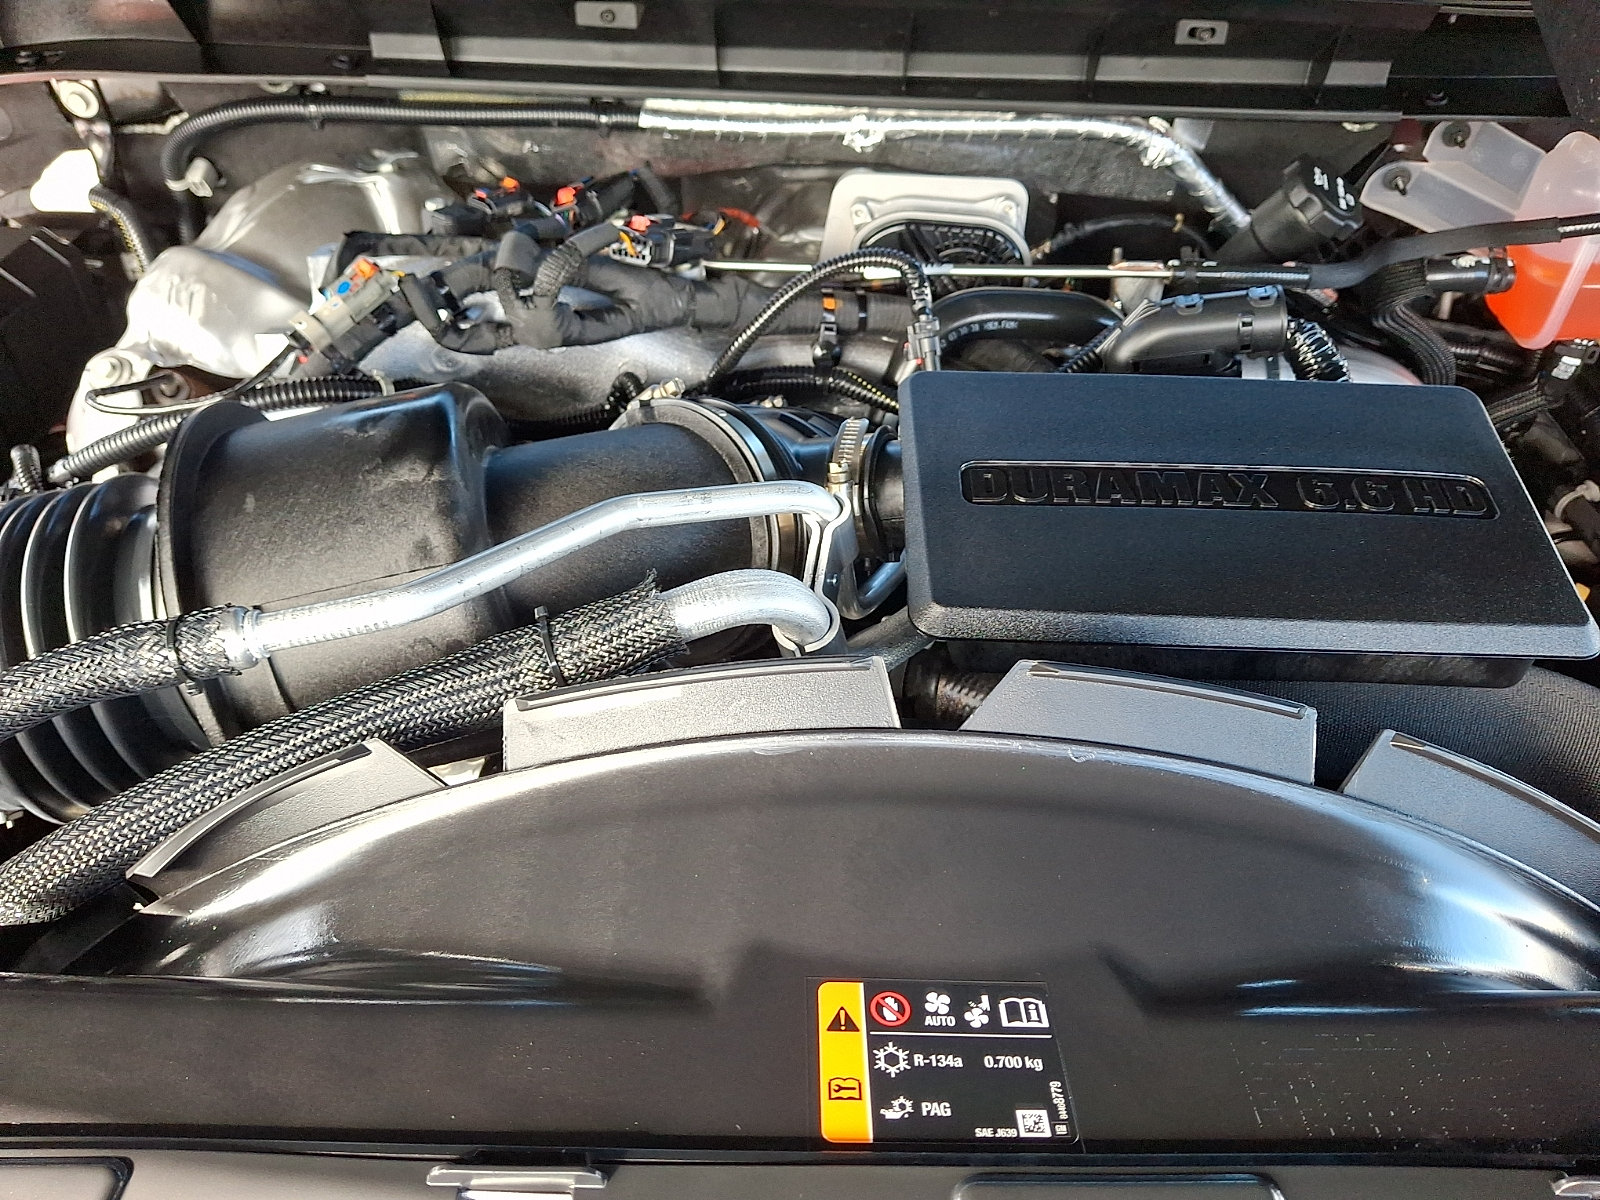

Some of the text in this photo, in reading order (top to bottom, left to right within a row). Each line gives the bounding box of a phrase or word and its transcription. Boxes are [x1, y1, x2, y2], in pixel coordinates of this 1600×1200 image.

[970, 468, 1488, 516] DURAMAX 6.6 HD
[924, 1015, 956, 1027] AUTO
[913, 1054, 1043, 1071] R-134a 0.700 kg
[921, 1102, 952, 1117] PAG
[974, 1128, 1018, 1138] SAE J639
